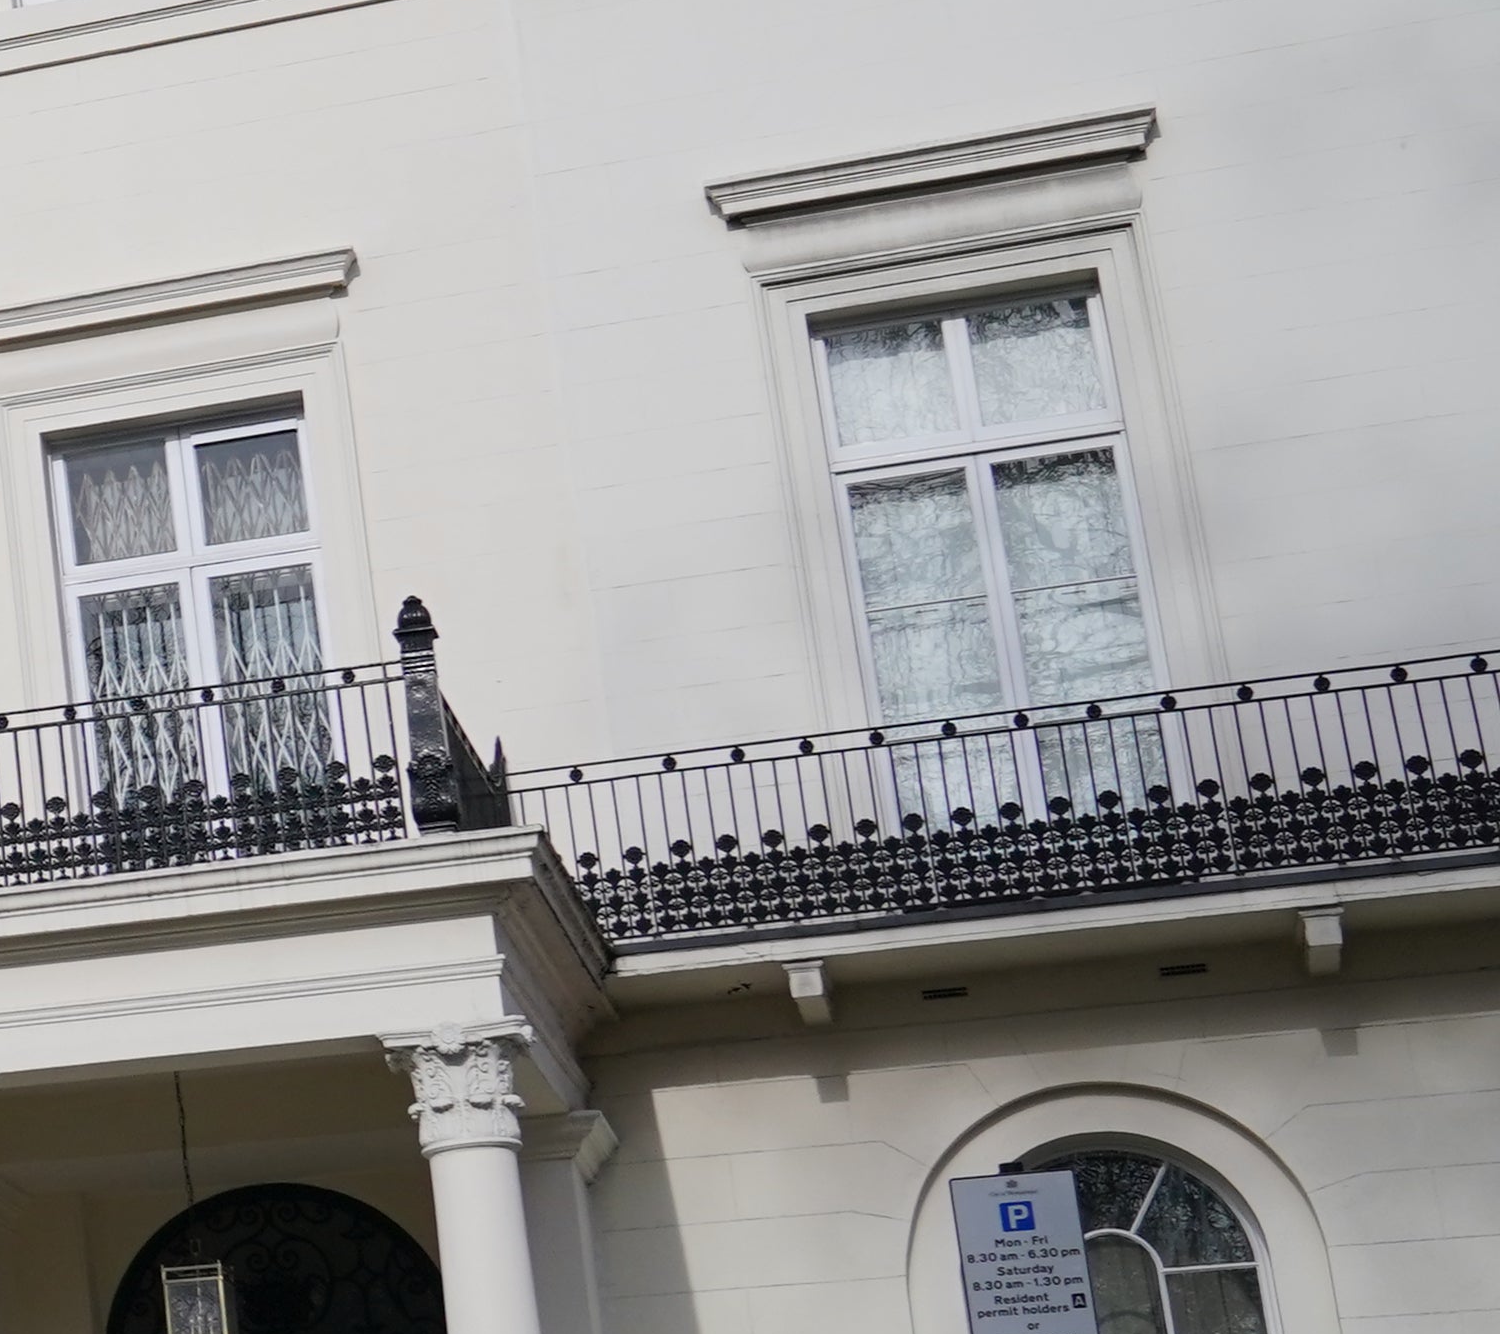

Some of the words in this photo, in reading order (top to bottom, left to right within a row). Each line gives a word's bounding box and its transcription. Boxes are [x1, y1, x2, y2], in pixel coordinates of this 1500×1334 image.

[1007, 1204, 1029, 1229] P
[994, 1238, 1022, 1248] Mon
[1032, 1235, 1049, 1245] Fri
[967, 1252, 997, 1263] 8.30
[1000, 1253, 1019, 1261] am
[1028, 1248, 1058, 1259] 6.30
[1061, 1248, 1081, 1258] pm
[996, 1264, 1054, 1276] Saturday
[972, 1280, 1002, 1291] 8.30
[1005, 1281, 1024, 1289] am
[1033, 1276, 1061, 1287] 1.30
[1064, 1276, 1083, 1286] pm
[994, 1292, 1049, 1305] Resident
[977, 1307, 1019, 1319] permit
[1022, 1303, 1070, 1314] holders
[1027, 1322, 1040, 1330] or
